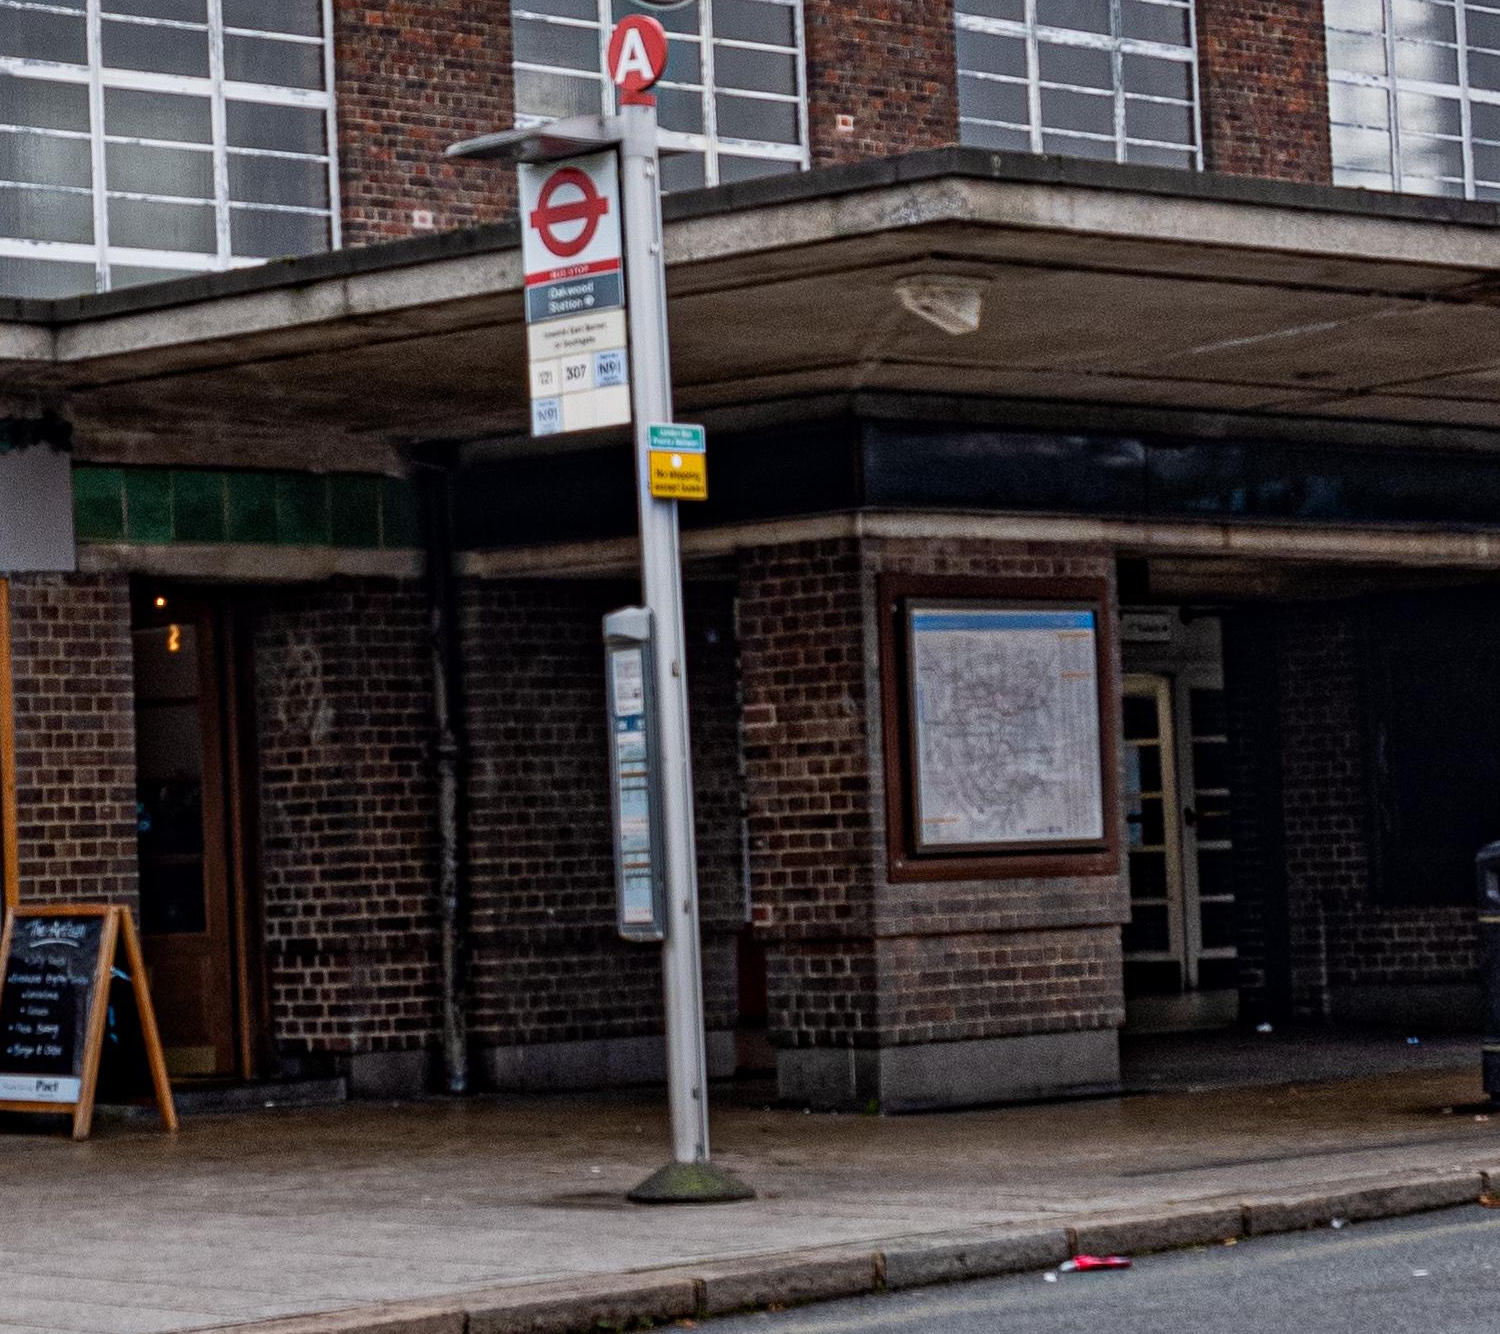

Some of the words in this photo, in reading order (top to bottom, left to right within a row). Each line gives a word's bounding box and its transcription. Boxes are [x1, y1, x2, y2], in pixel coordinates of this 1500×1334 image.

[615, 26, 654, 85] A
[548, 281, 594, 299] Oakwood
[548, 298, 583, 313] Station
[566, 365, 587, 380] 307
[598, 362, 622, 376] N91
